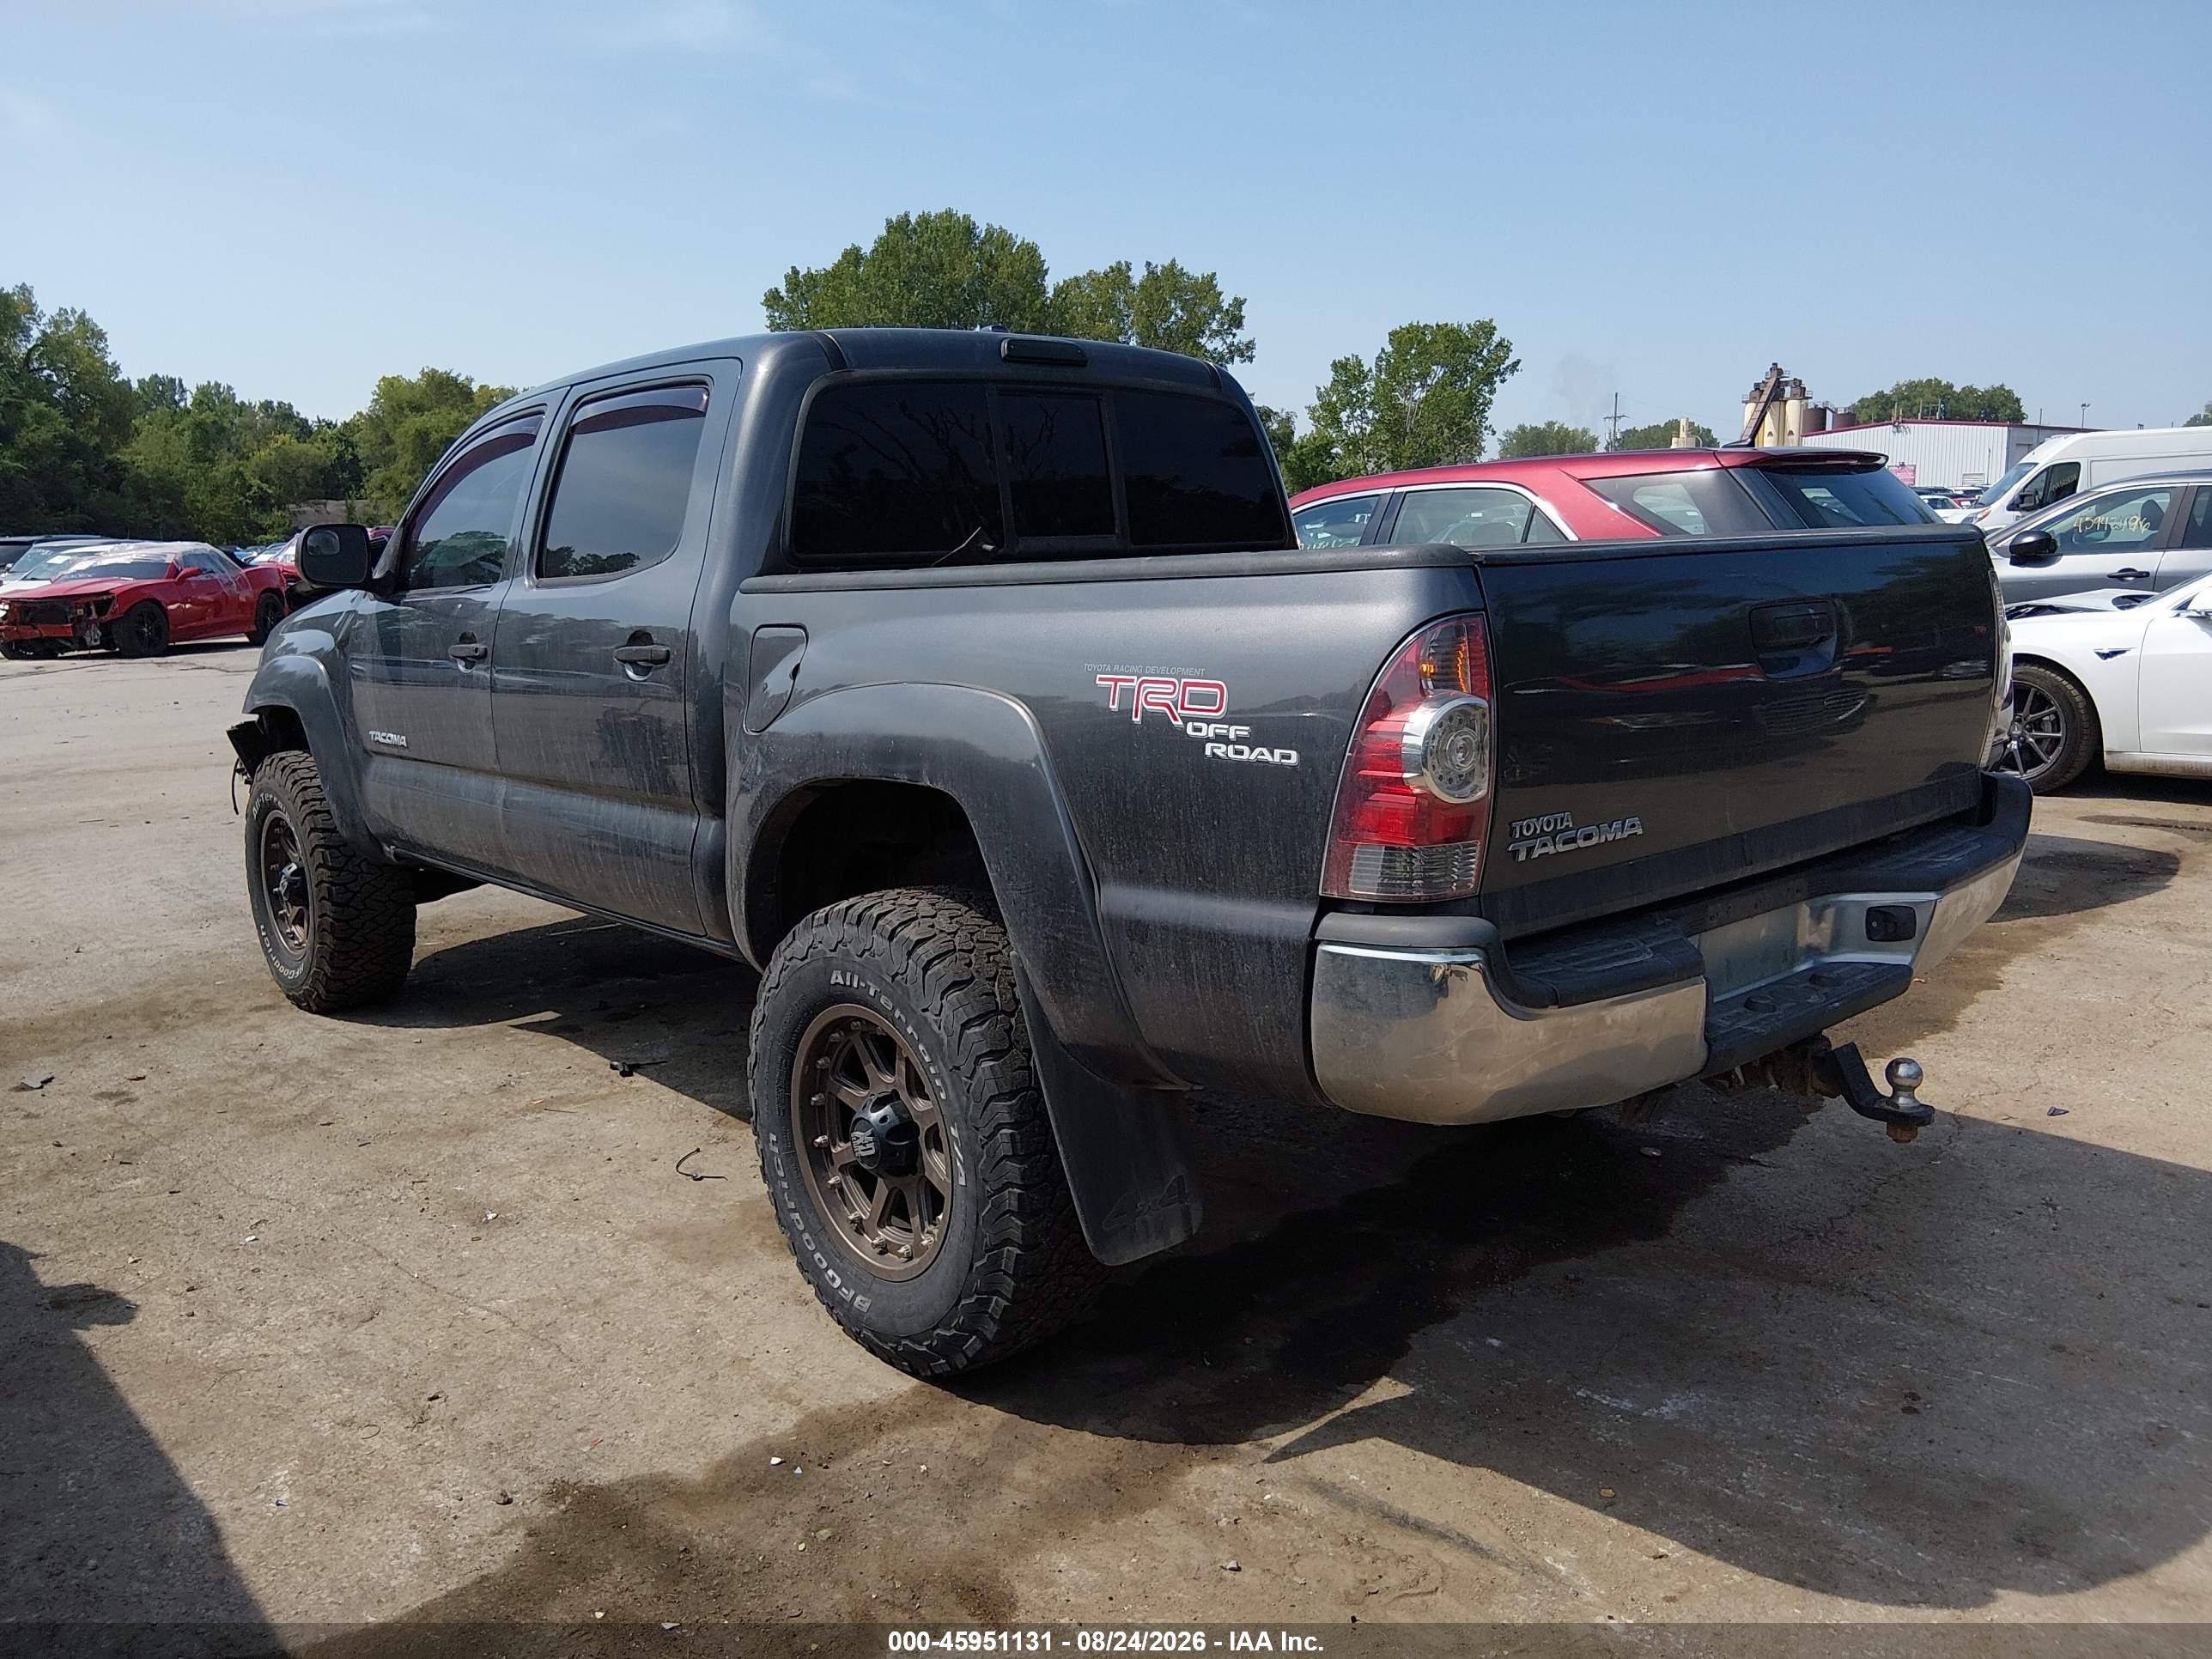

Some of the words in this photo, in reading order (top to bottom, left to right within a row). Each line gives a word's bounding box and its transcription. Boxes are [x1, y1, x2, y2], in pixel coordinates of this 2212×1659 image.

[1084, 663, 1111, 673] TOYOTA
[1114, 664, 1143, 674] RACING
[1145, 665, 1206, 677] DEVELOPMENT
[1095, 674, 1229, 729] TRD
[368, 730, 407, 748] TACOMA
[1186, 721, 1252, 742] OFF
[1204, 742, 1300, 768] ROAD
[1511, 811, 1573, 839] TOYOTA
[1508, 817, 1644, 862] TACOMA
[769, 1132, 873, 1313] BFGoodrich
